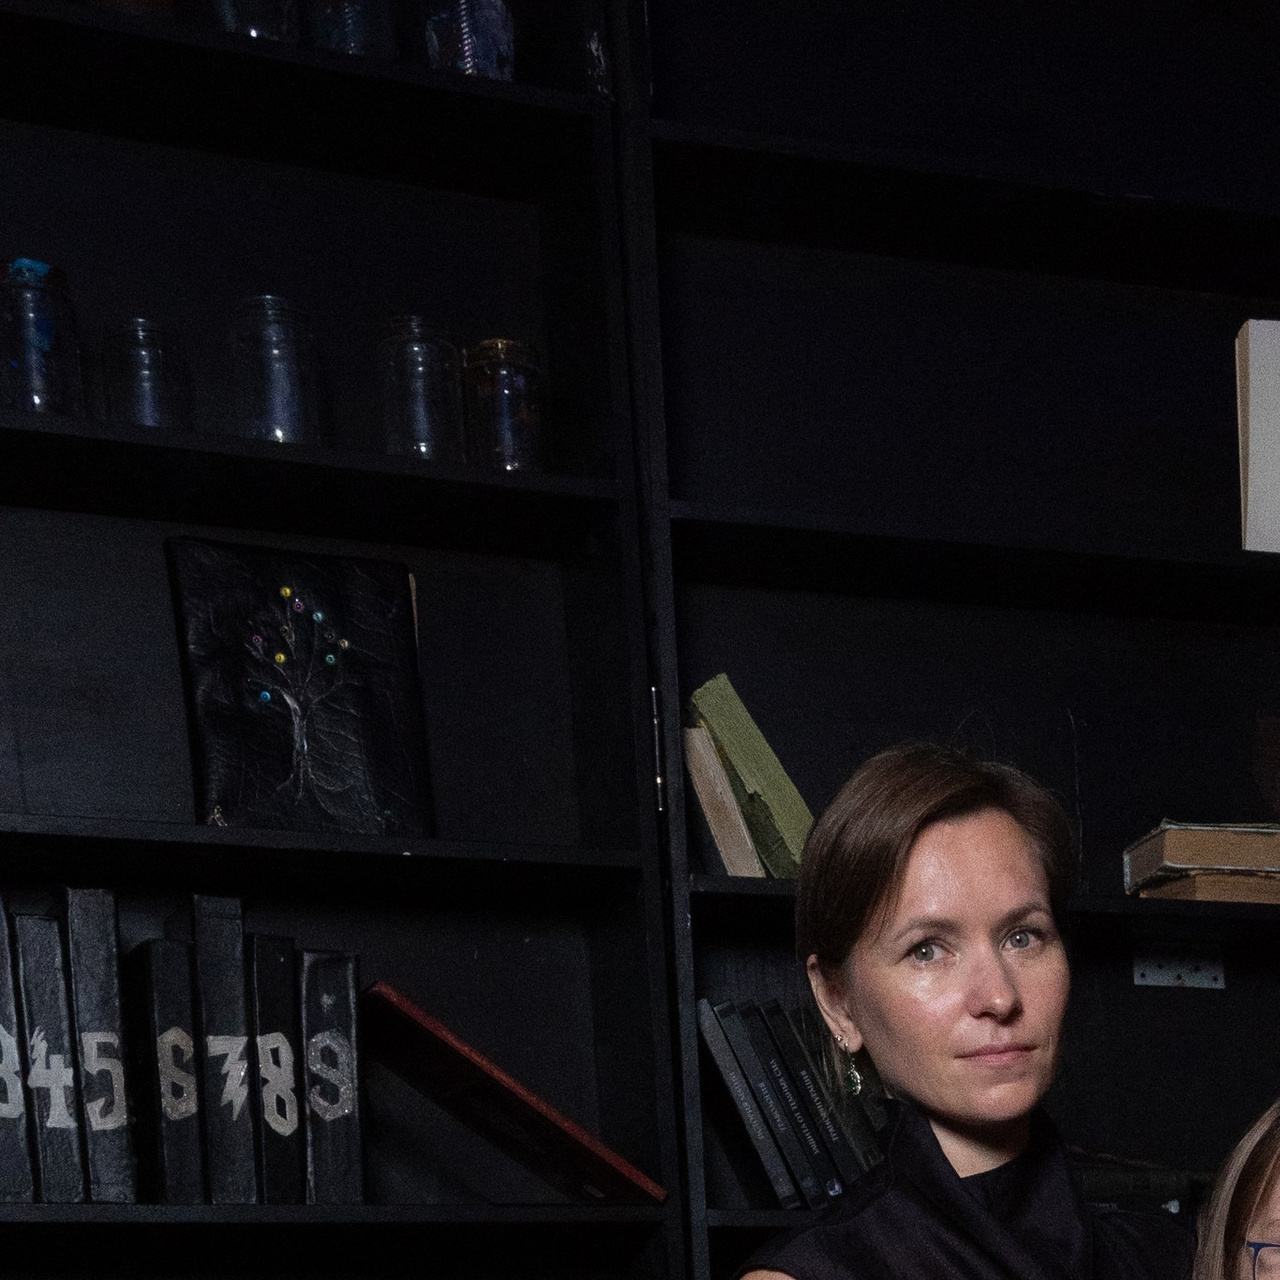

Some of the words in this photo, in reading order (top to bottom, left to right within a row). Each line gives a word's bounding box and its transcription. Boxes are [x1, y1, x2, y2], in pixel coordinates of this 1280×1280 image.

[27, 1026, 78, 1128] 4
[81, 1032, 128, 1131] 5
[206, 1035, 249, 1121] 7
[256, 1031, 299, 1137] 8
[769, 1058, 782, 1077] СИЛ
[800, 1121, 820, 1155] ЗАЩИТА
